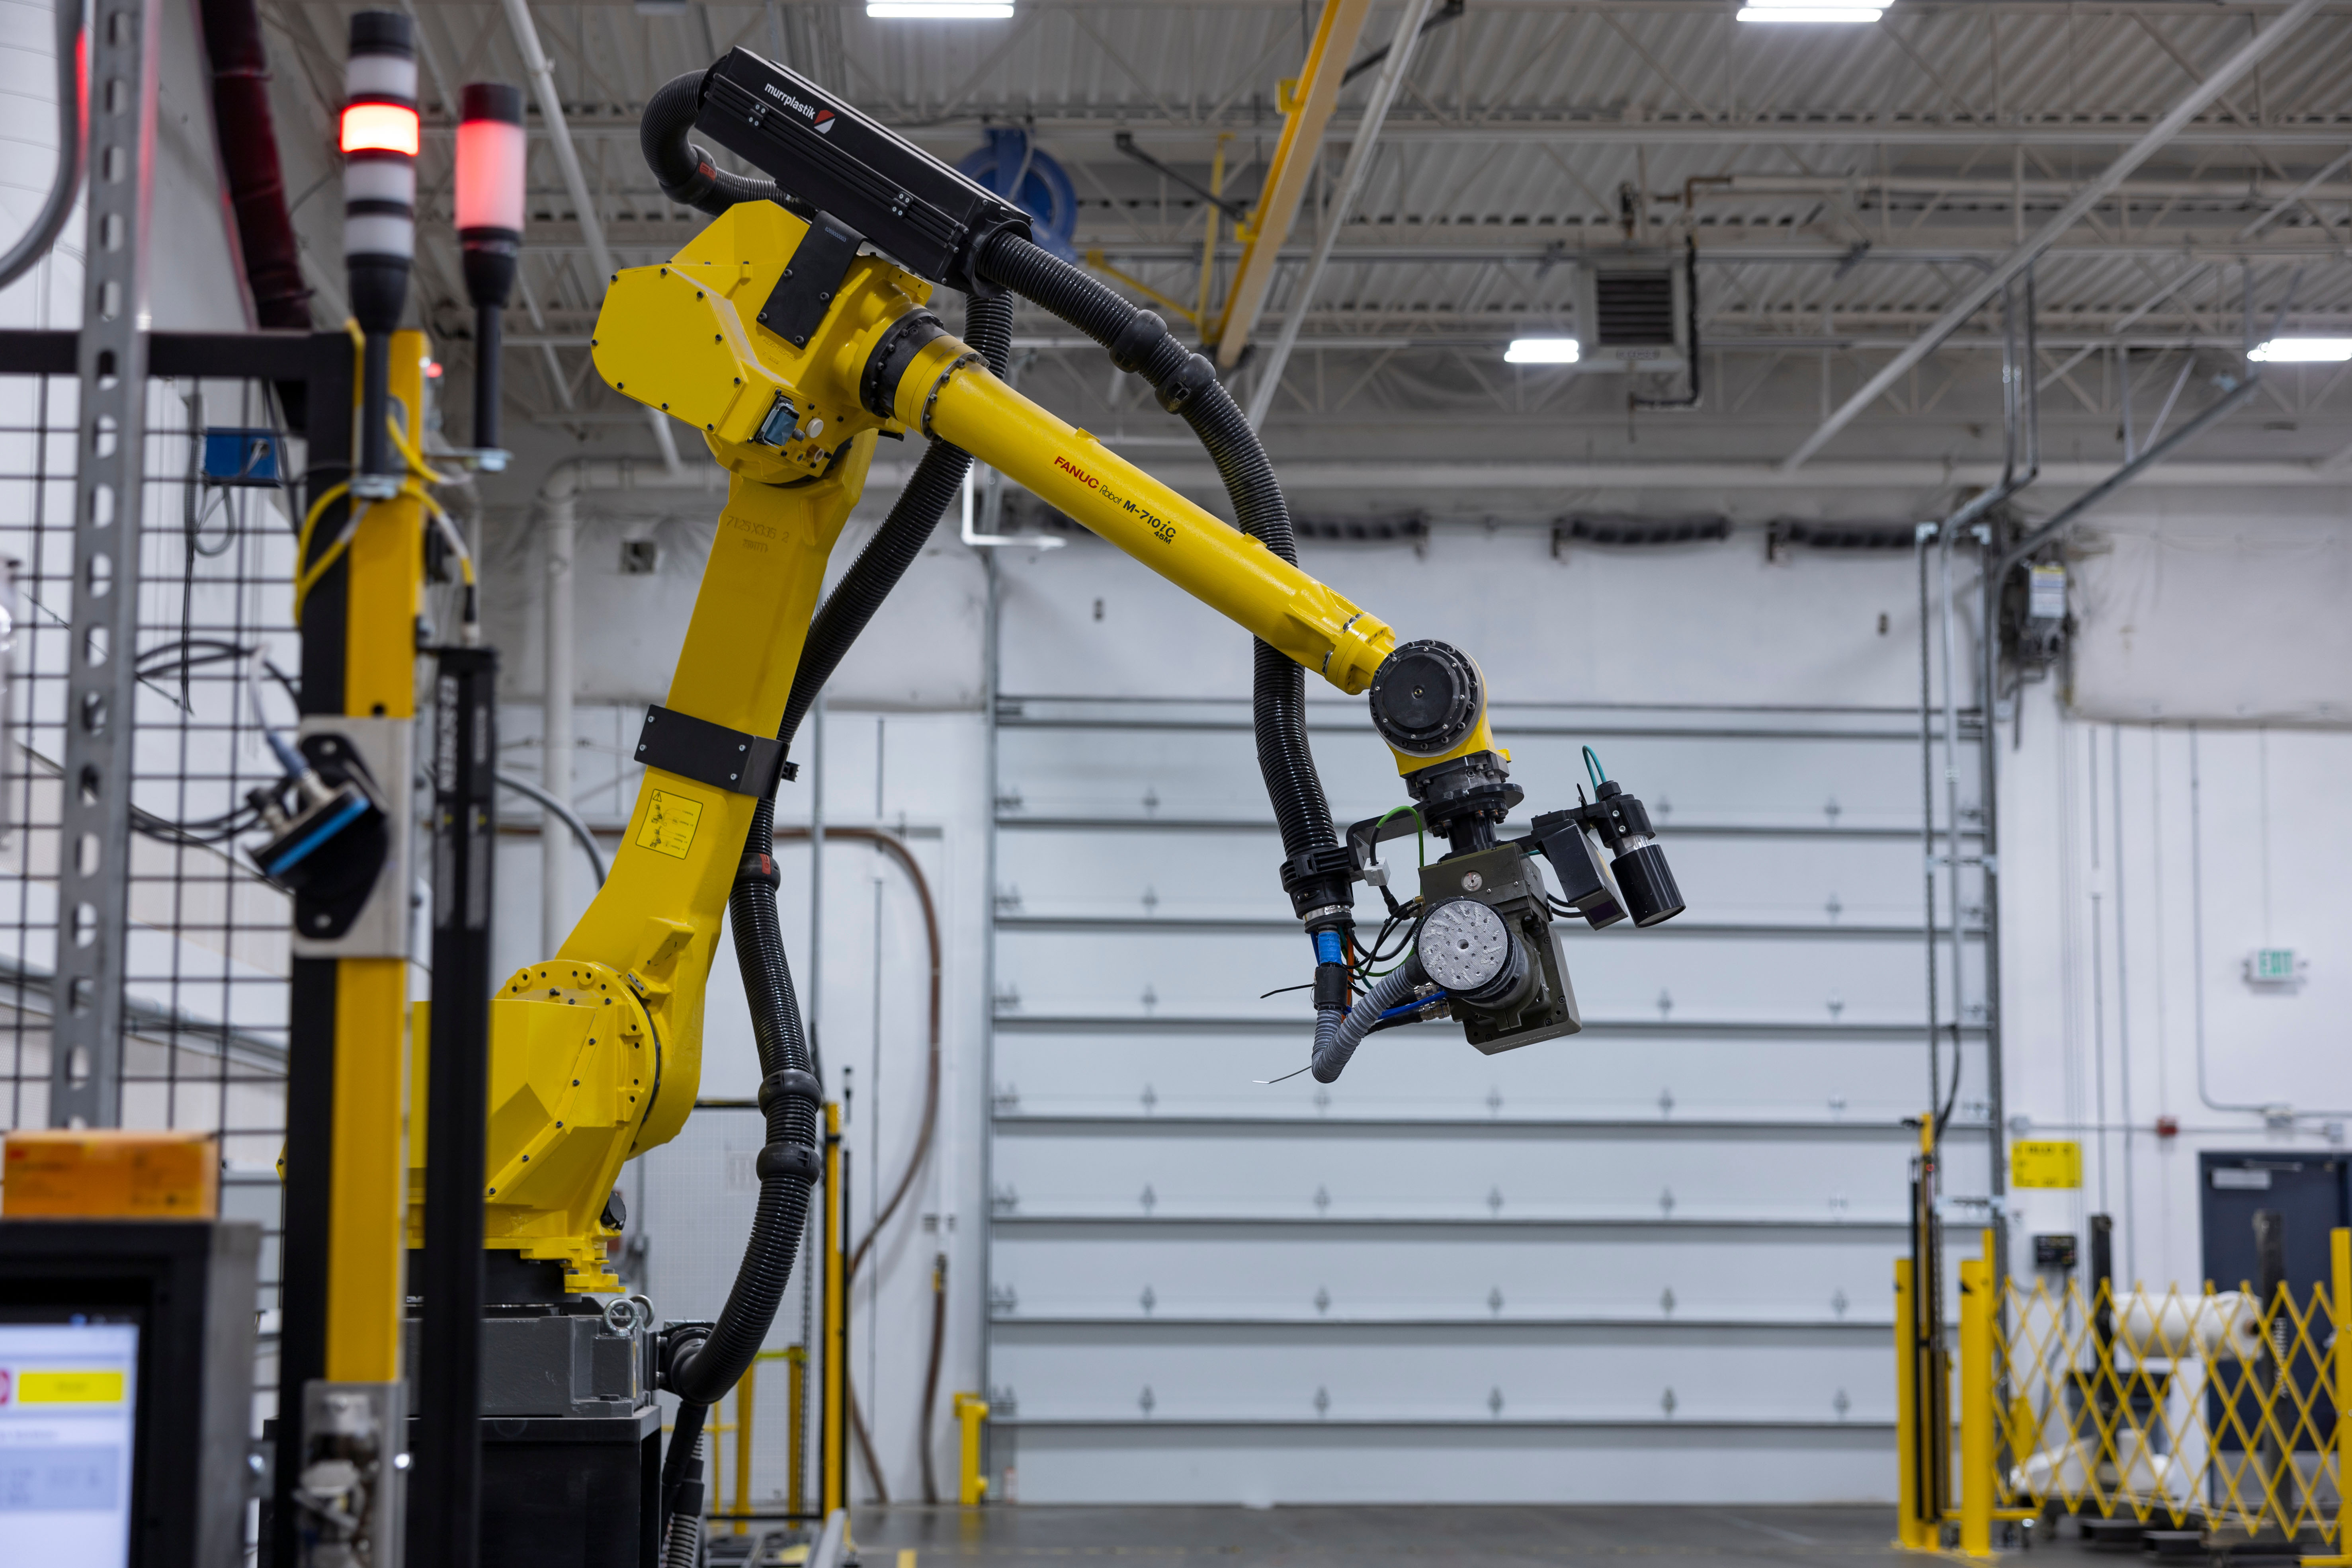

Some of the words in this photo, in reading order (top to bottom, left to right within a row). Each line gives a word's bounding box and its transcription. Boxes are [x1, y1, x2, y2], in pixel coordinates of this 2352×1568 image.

[764, 83, 816, 120] murrplastik
[1054, 456, 1099, 488] FANUC
[1099, 484, 1122, 504] Robot
[1123, 500, 1176, 538] M-710iC
[1154, 531, 1172, 545] 45M
